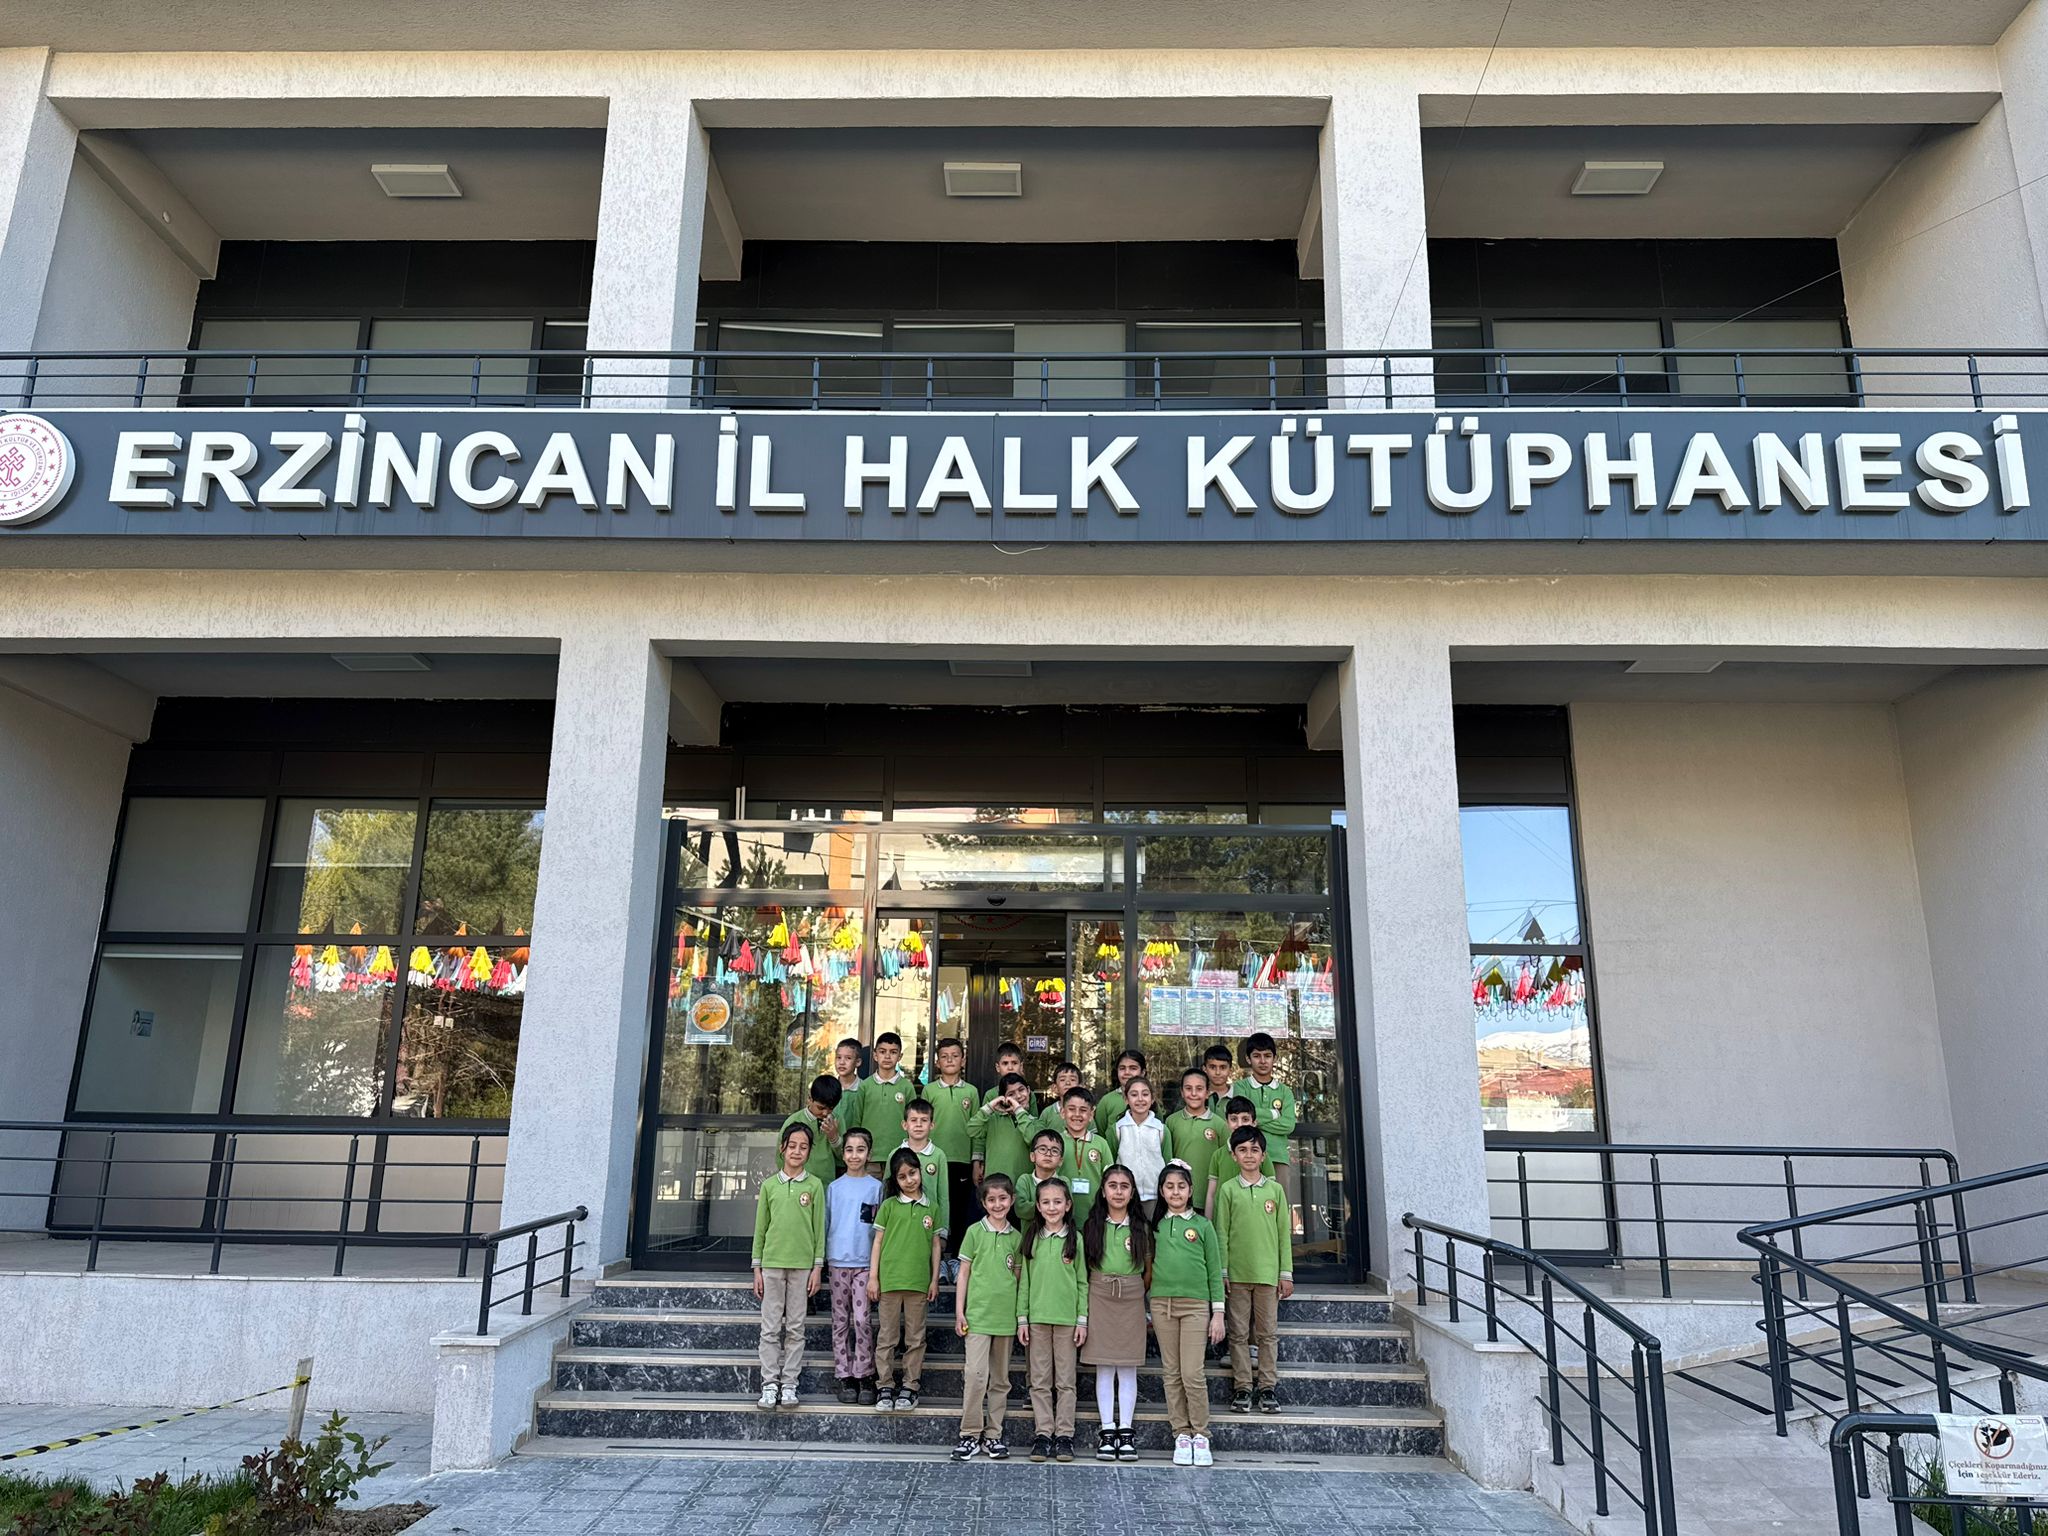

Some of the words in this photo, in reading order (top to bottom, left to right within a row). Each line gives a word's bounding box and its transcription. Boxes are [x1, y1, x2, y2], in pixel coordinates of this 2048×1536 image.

[29, 441, 37, 449] VE
[108, 414, 675, 511] ERZİNCAN
[715, 416, 807, 512] İL
[844, 435, 1141, 514] HALK
[1186, 414, 2031, 514] KÜTÜPHANESİ
[1029, 1038, 1046, 1049] GİRİŞ
[1948, 1460, 1983, 1469] Çiçekleri
[1958, 1469, 1974, 1479] İçin
